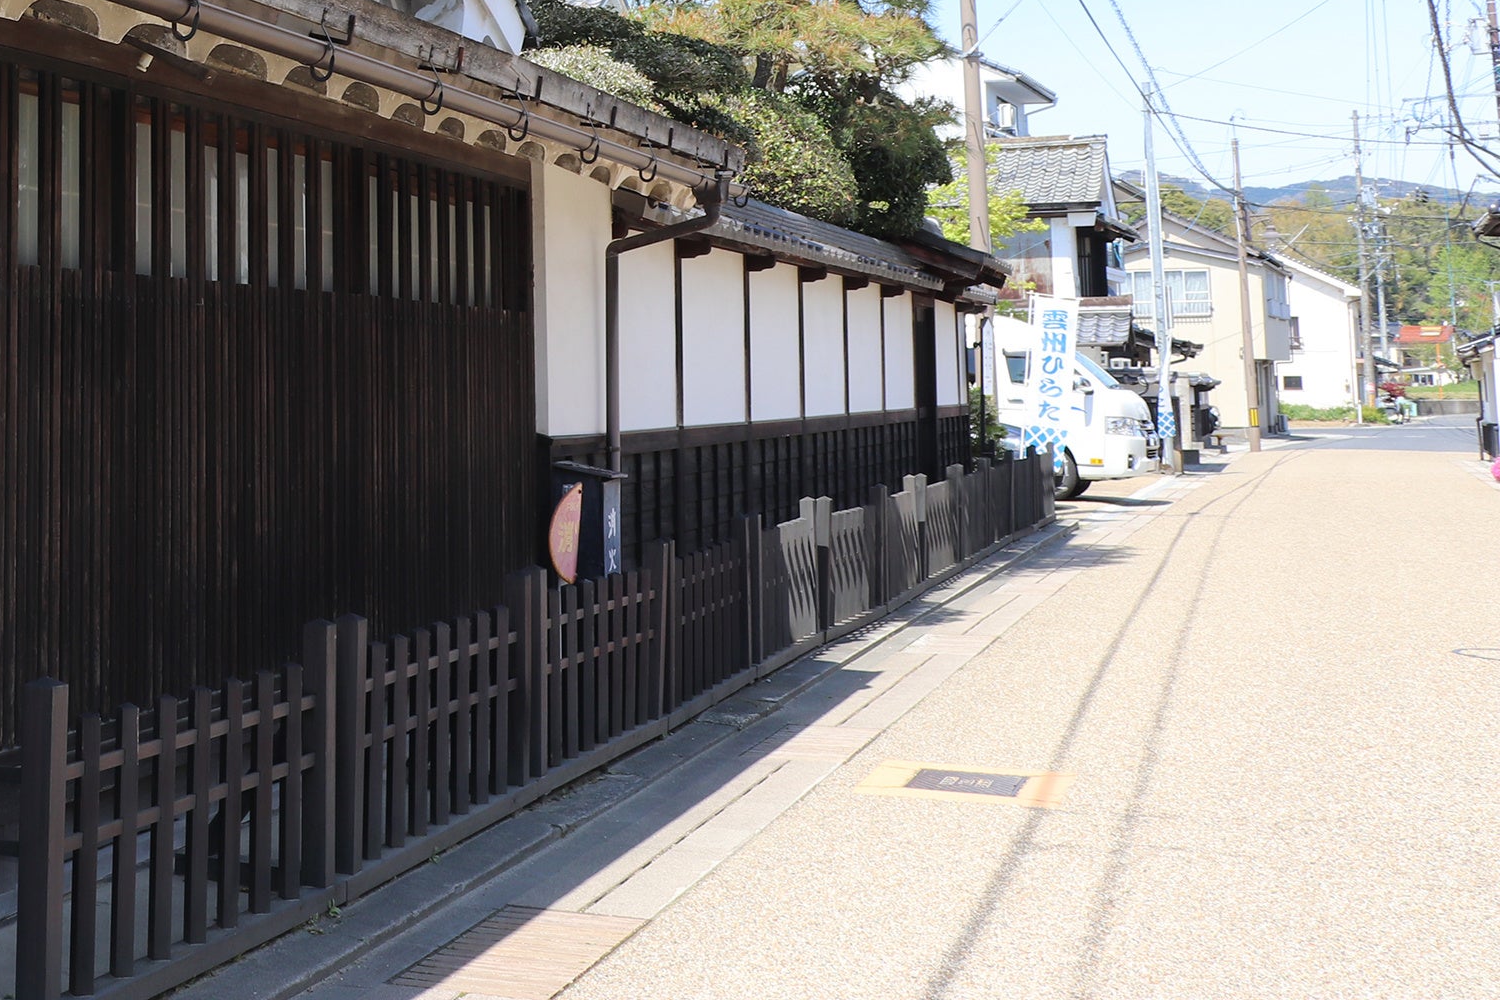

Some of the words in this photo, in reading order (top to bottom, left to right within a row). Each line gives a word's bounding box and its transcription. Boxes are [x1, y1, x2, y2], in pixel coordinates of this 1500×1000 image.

[1039, 310, 1069, 422] 雲州ひらた
